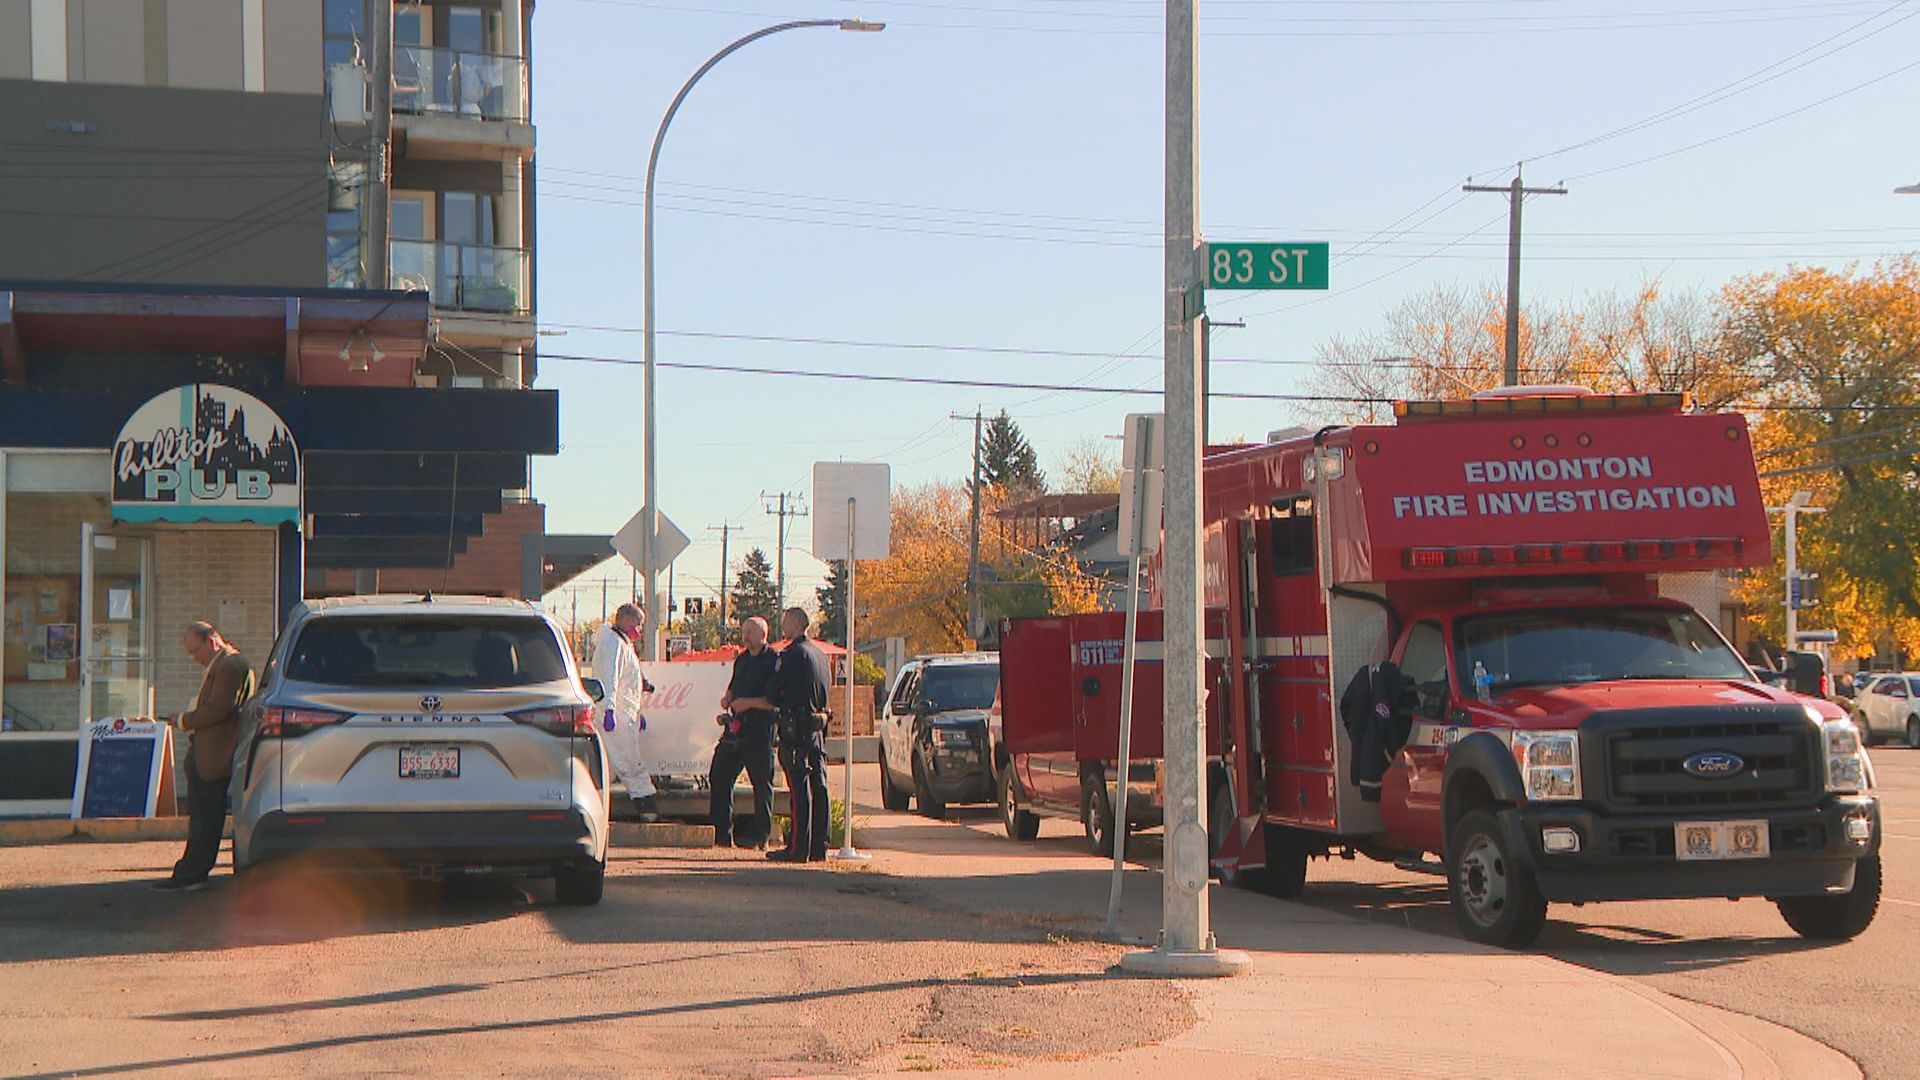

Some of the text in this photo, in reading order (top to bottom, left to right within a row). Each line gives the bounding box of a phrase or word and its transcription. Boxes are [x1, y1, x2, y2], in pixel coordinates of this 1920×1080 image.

[1213, 248, 1309, 284] 83 ST
[118, 427, 228, 483] hilltop
[1463, 455, 1653, 483] EDMONTON
[145, 469, 273, 499] PUB
[1393, 484, 1737, 519] FIRE INVESTIGATION
[1080, 639, 1125, 649] EMERGENC
[1081, 647, 1104, 666] 911
[381, 715, 481, 723] SIENNA
[667, 760, 699, 771] HILLTOP
[1697, 756, 1732, 772] Ford
